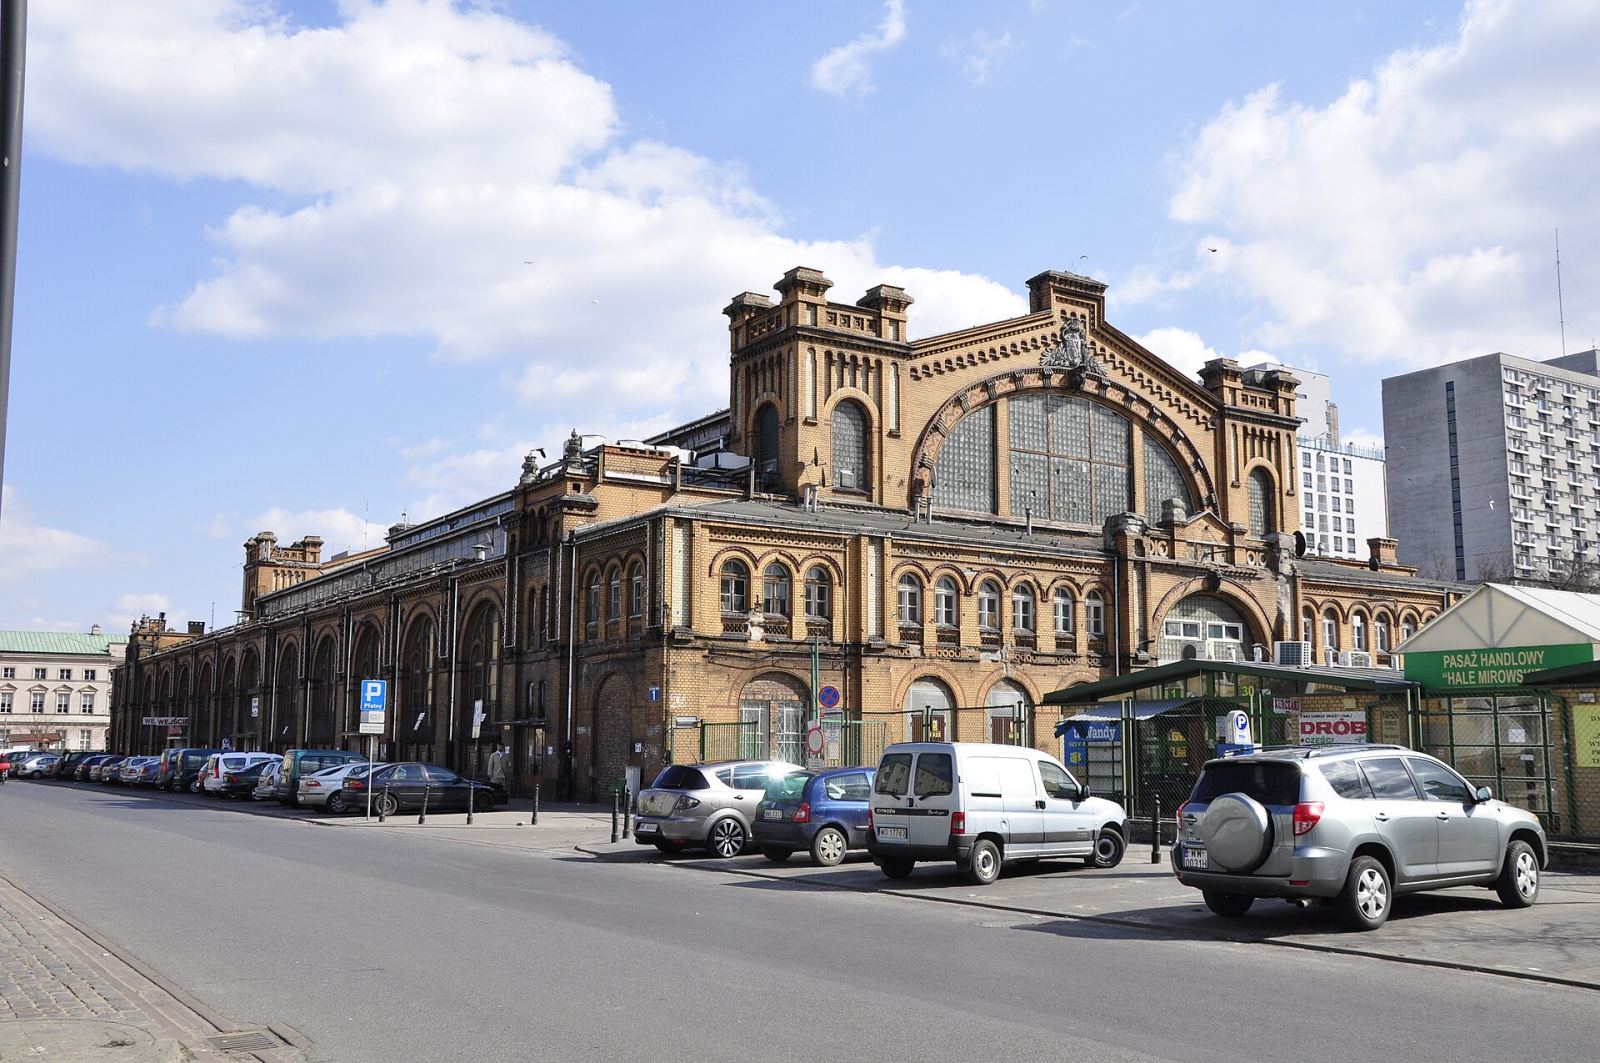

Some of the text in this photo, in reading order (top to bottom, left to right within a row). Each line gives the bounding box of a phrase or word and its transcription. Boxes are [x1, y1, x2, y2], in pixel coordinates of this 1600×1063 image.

[1443, 651, 1545, 668] PASAŻ HANDLOWY
[1478, 668, 1548, 684] MIROWS
[652, 690, 656, 701] 1
[1242, 686, 1255, 696] 30
[1300, 718, 1368, 735] DRÓB
